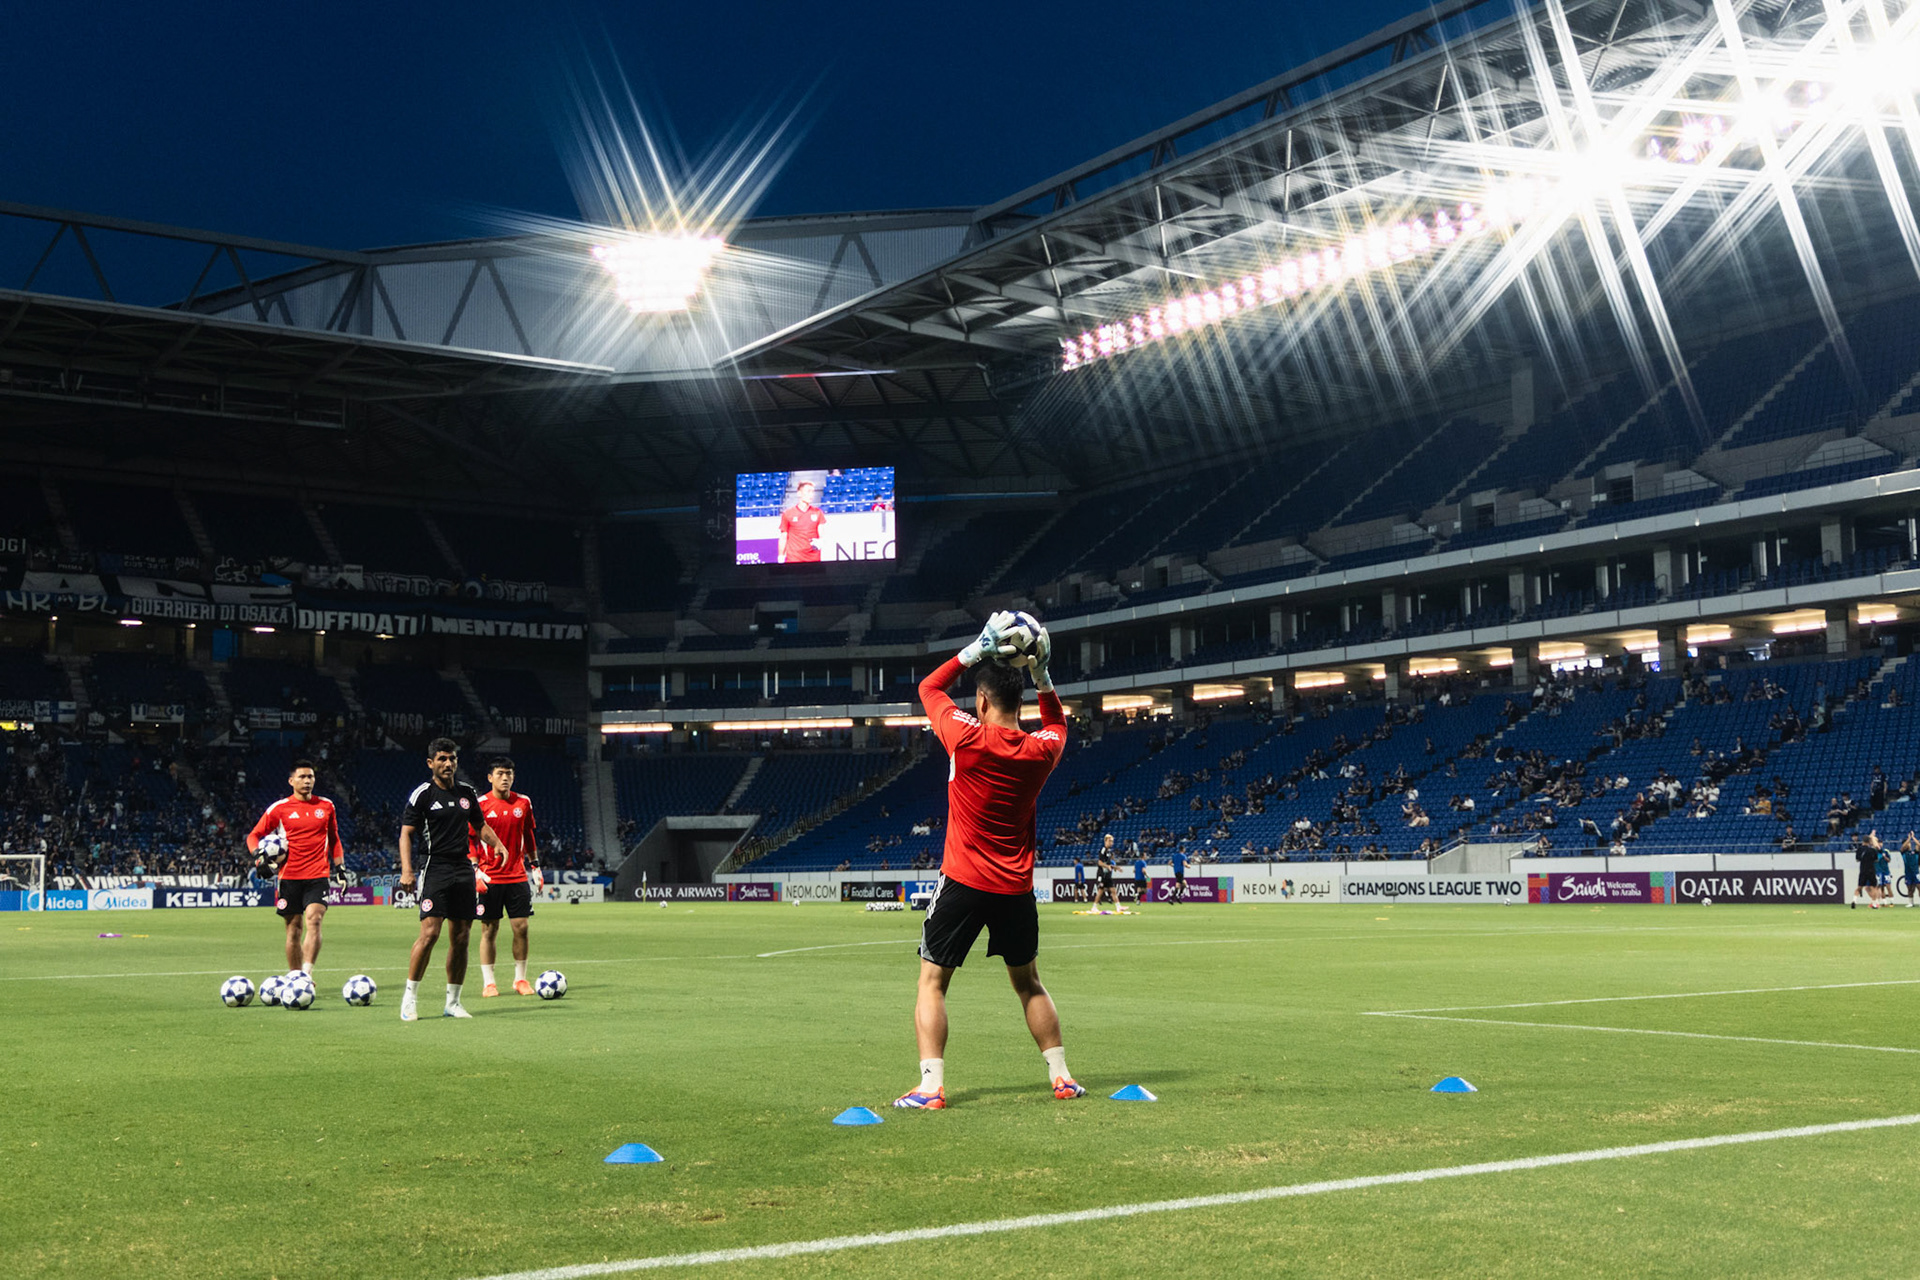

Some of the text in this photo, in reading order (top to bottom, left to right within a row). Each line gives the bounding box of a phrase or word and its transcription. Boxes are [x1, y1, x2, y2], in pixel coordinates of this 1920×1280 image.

[131, 597, 288, 624] GUERRIERI DI OSAKA
[298, 608, 418, 636] DIFFIDATI
[786, 885, 837, 899] NEOM.COM
[851, 886, 895, 898] Football Cares
[1242, 883, 1277, 895] NEOM
[1300, 880, 1330, 898] نيوم
[1429, 881, 1482, 896] LEAGUE
[1486, 881, 1522, 896] TWO
[1557, 875, 1607, 901] Saudi
[1606, 881, 1637, 889] Welcome
[1619, 888, 1642, 896] Arabia
[1680, 877, 1838, 896] QATAR AIRWAYS
[166, 891, 244, 908] KELME
[634, 887, 725, 898] QATAR AIRWAYS
[104, 896, 148, 909] Midea
